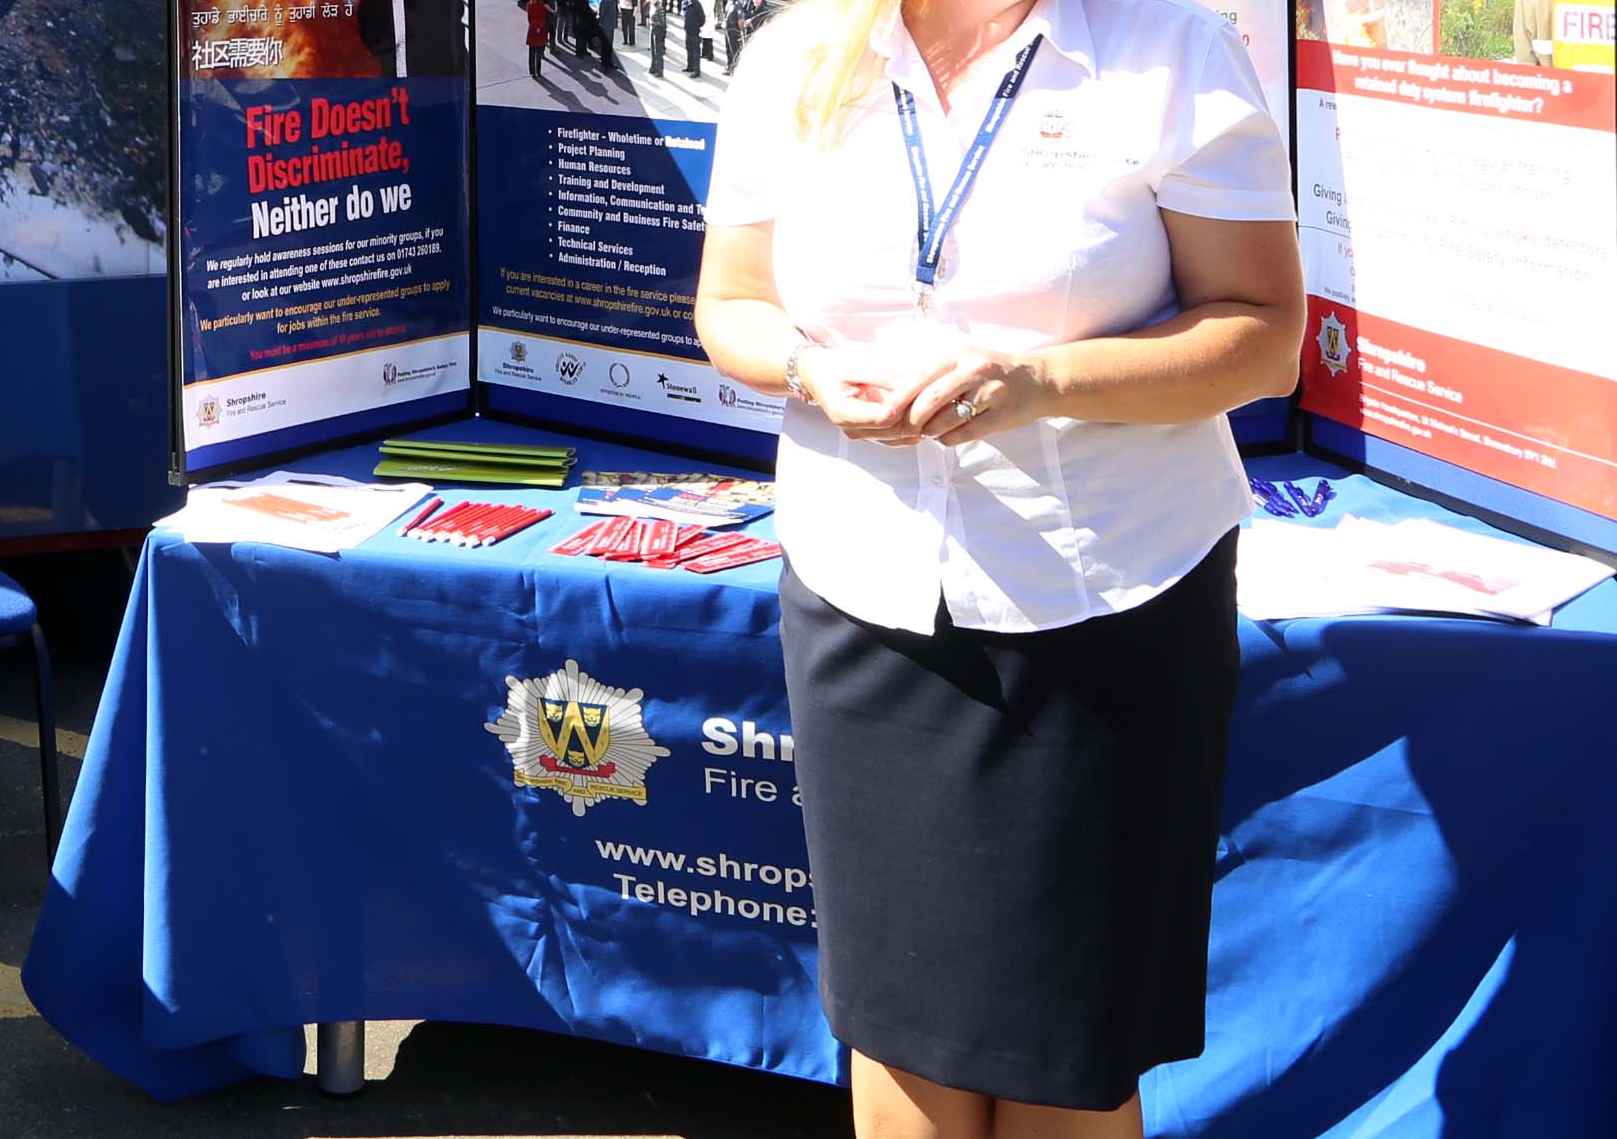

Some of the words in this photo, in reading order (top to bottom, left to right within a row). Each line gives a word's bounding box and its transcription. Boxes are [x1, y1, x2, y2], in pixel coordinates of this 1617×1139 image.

[192, 37, 283, 71] 社区需要你
[1452, 65, 1490, 85] about
[1494, 68, 1560, 96] becoming
[1423, 86, 1466, 104] system
[1469, 89, 1544, 114] firefighter?
[246, 105, 301, 149] Fire
[310, 87, 410, 139] Doesn't
[558, 128, 600, 141] Firefighter
[608, 132, 652, 146] Wholetime
[247, 136, 410, 194] Discriminate,
[558, 143, 587, 156] Project
[589, 145, 625, 161] Planning
[558, 159, 586, 171] Human
[589, 162, 631, 175] Resources
[558, 174, 591, 189] Training
[594, 179, 608, 189] and
[612, 179, 665, 195] Development
[1313, 183, 1342, 206] Giving
[251, 192, 339, 239] Neither
[346, 184, 373, 220] do
[380, 184, 412, 211] we
[558, 190, 608, 206] Information,
[610, 195, 675, 212] Communication
[677, 203, 693, 214] and
[558, 206, 603, 222] Community
[605, 212, 621, 222] and
[623, 213, 660, 227] Business
[663, 217, 679, 228] Fire
[682, 220, 706, 232] Safet
[558, 221, 590, 234] Finance
[206, 260, 218, 271] We
[220, 255, 253, 271] regularly
[254, 251, 271, 264] hold
[272, 248, 311, 261] awareness
[313, 242, 343, 256] sessions
[346, 240, 355, 250] for
[357, 239, 368, 248] our
[370, 234, 398, 247] minority
[558, 236, 596, 251] Technical
[598, 242, 633, 255] Services
[207, 280, 219, 289] are
[222, 270, 259, 286] interested
[270, 265, 303, 279] attending
[305, 263, 318, 273] one
[329, 258, 351, 269] these
[349, 254, 374, 268] contact
[397, 247, 416, 259] 01743
[558, 252, 616, 270] Administration
[624, 262, 666, 276] Reception
[252, 288, 268, 300] look
[294, 279, 320, 293] website
[506, 286, 530, 296] current
[531, 289, 565, 301] vacancies
[533, 274, 565, 287] interested
[640, 290, 668, 301] service
[669, 292, 695, 305] please
[213, 312, 254, 331] particularly
[256, 309, 274, 320] want
[285, 302, 322, 316] encourage
[289, 320, 305, 334] jobs
[503, 308, 534, 322] particularly
[557, 317, 588, 331] encourage
[661, 333, 684, 344] groups
[227, 392, 266, 407] Shropshire
[704, 767, 778, 803] Fire
[595, 839, 812, 893] www.shrop
[613, 873, 818, 929] Telephone:
